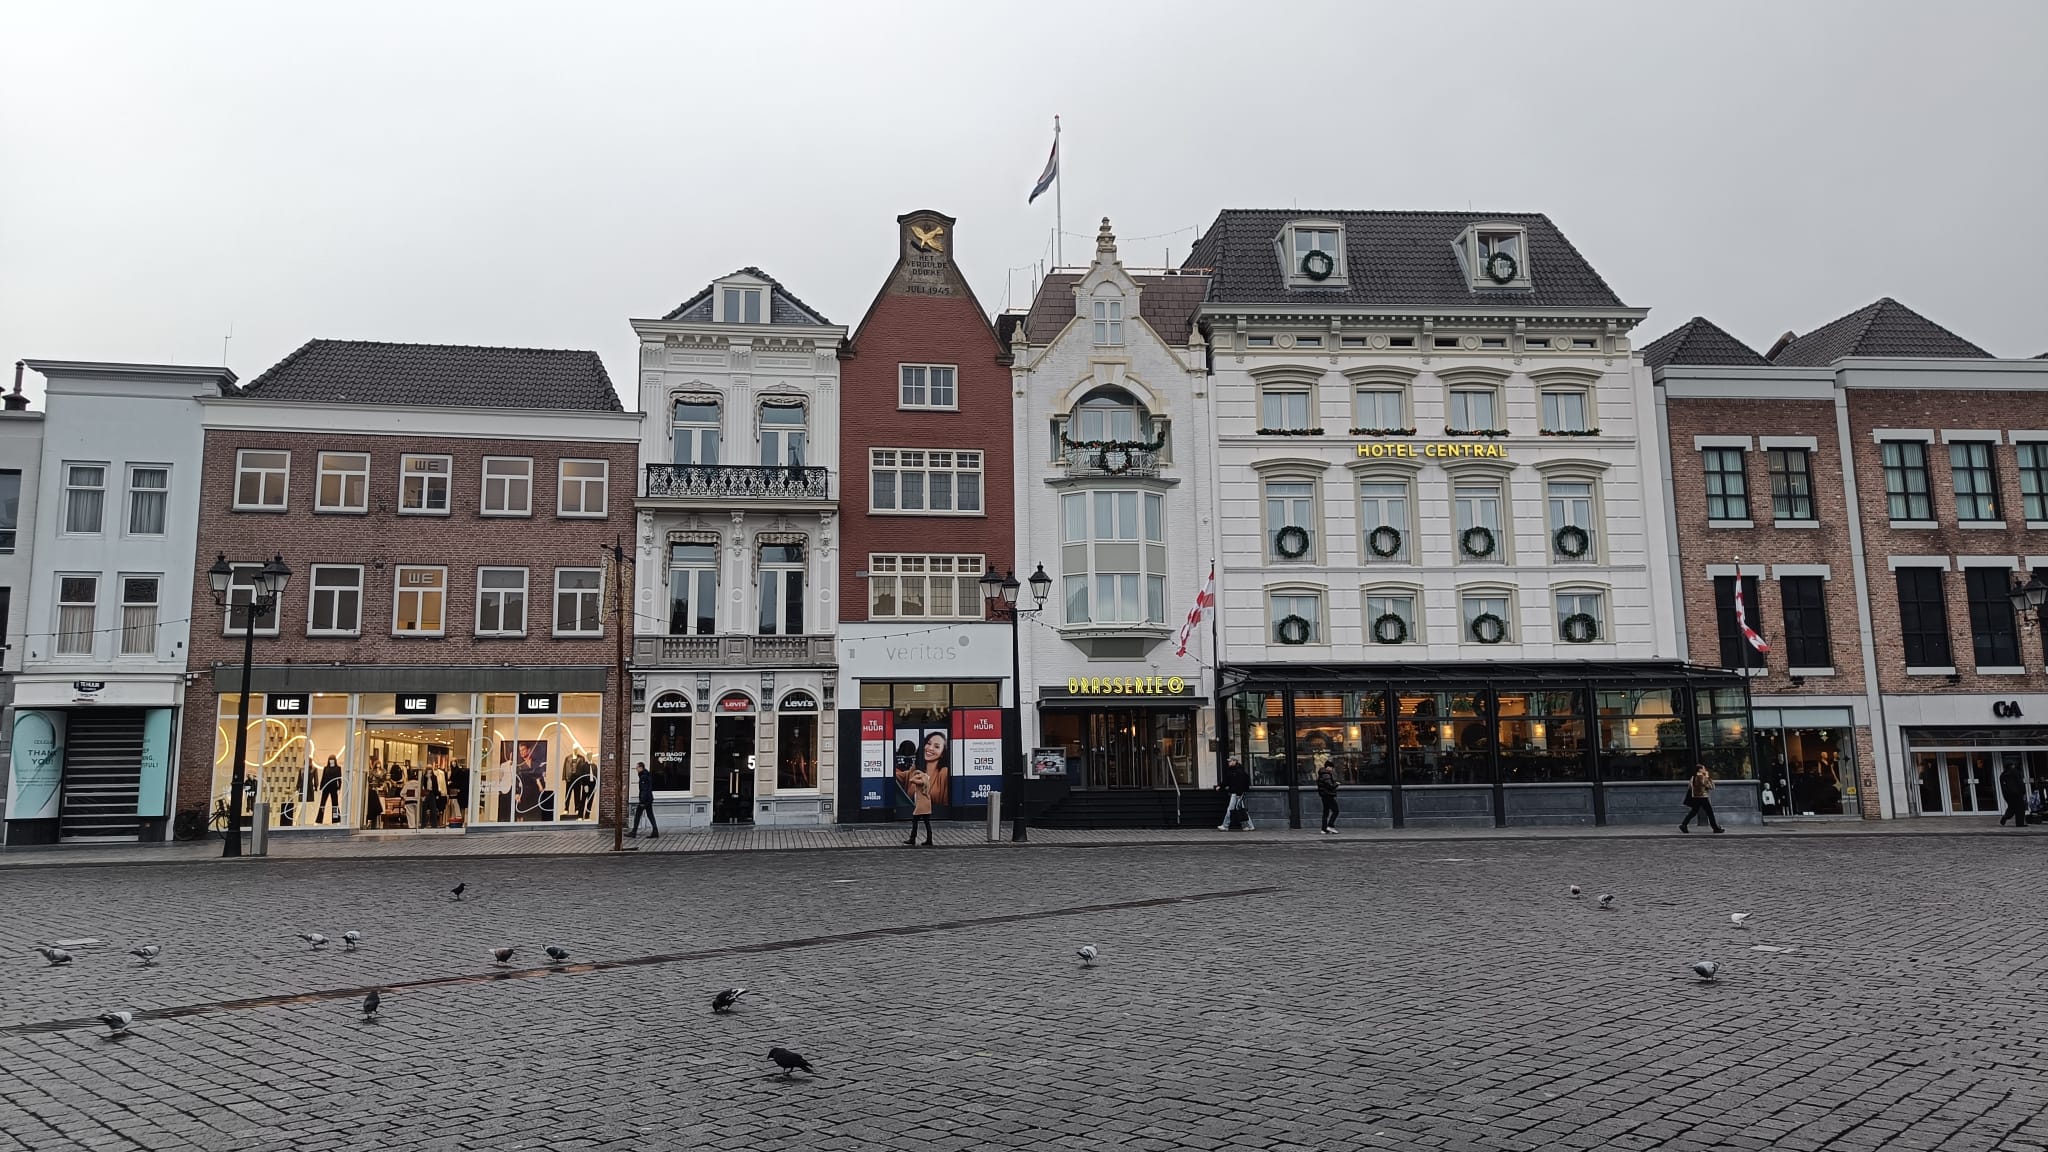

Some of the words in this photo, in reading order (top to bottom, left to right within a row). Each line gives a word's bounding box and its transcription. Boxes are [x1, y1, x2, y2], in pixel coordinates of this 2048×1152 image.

[906, 261, 948, 269] VERGULDE
[905, 285, 925, 293] JULI
[928, 287, 950, 295] 1945
[1356, 443, 1418, 457] HOTEL
[1424, 443, 1508, 457] CENTRAL
[415, 460, 439, 471] WE
[408, 572, 433, 584] WE
[886, 643, 957, 661] veritas
[1067, 676, 1164, 694] BRASSERIE
[277, 698, 300, 710] WE
[404, 698, 427, 710] WE
[527, 698, 550, 709] WE
